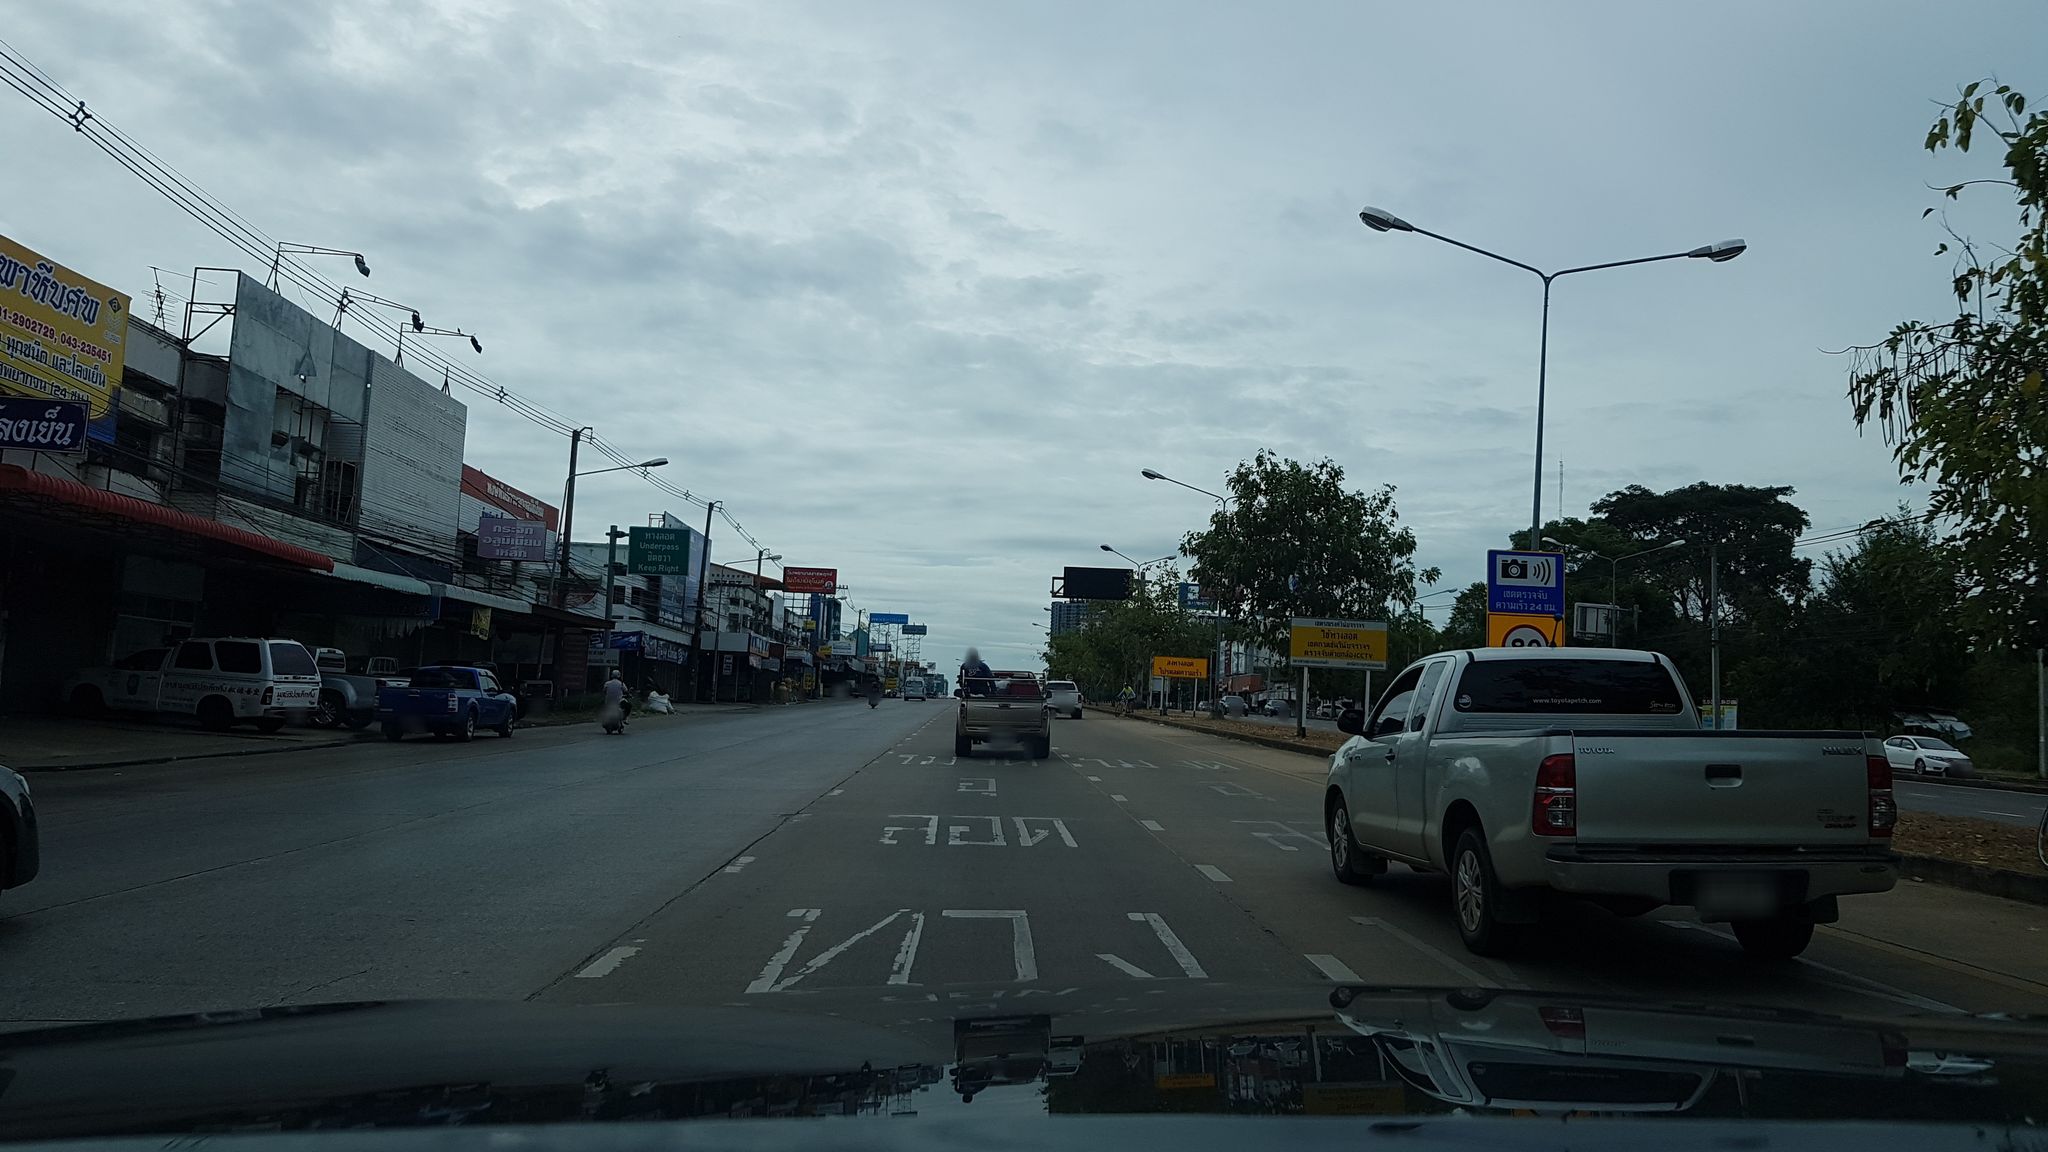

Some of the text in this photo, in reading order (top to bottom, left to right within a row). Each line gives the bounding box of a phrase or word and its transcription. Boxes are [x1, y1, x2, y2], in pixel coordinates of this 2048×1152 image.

[0, 306, 58, 343] 1-2902729,
[0, 405, 75, 446] ลงเย็น
[493, 525, 534, 535] กระจก
[645, 532, 675, 541] ทางลอด
[640, 541, 680, 552] Underpass
[647, 551, 672, 563] ชิดขวา
[638, 563, 680, 574] Keep Right
[1495, 599, 1528, 610] ความเร็ว
[1530, 603, 1542, 611] 24
[1579, 745, 1615, 755] TOYOTA
[879, 815, 1079, 848] ลอด
[744, 908, 1208, 993] ทาง
